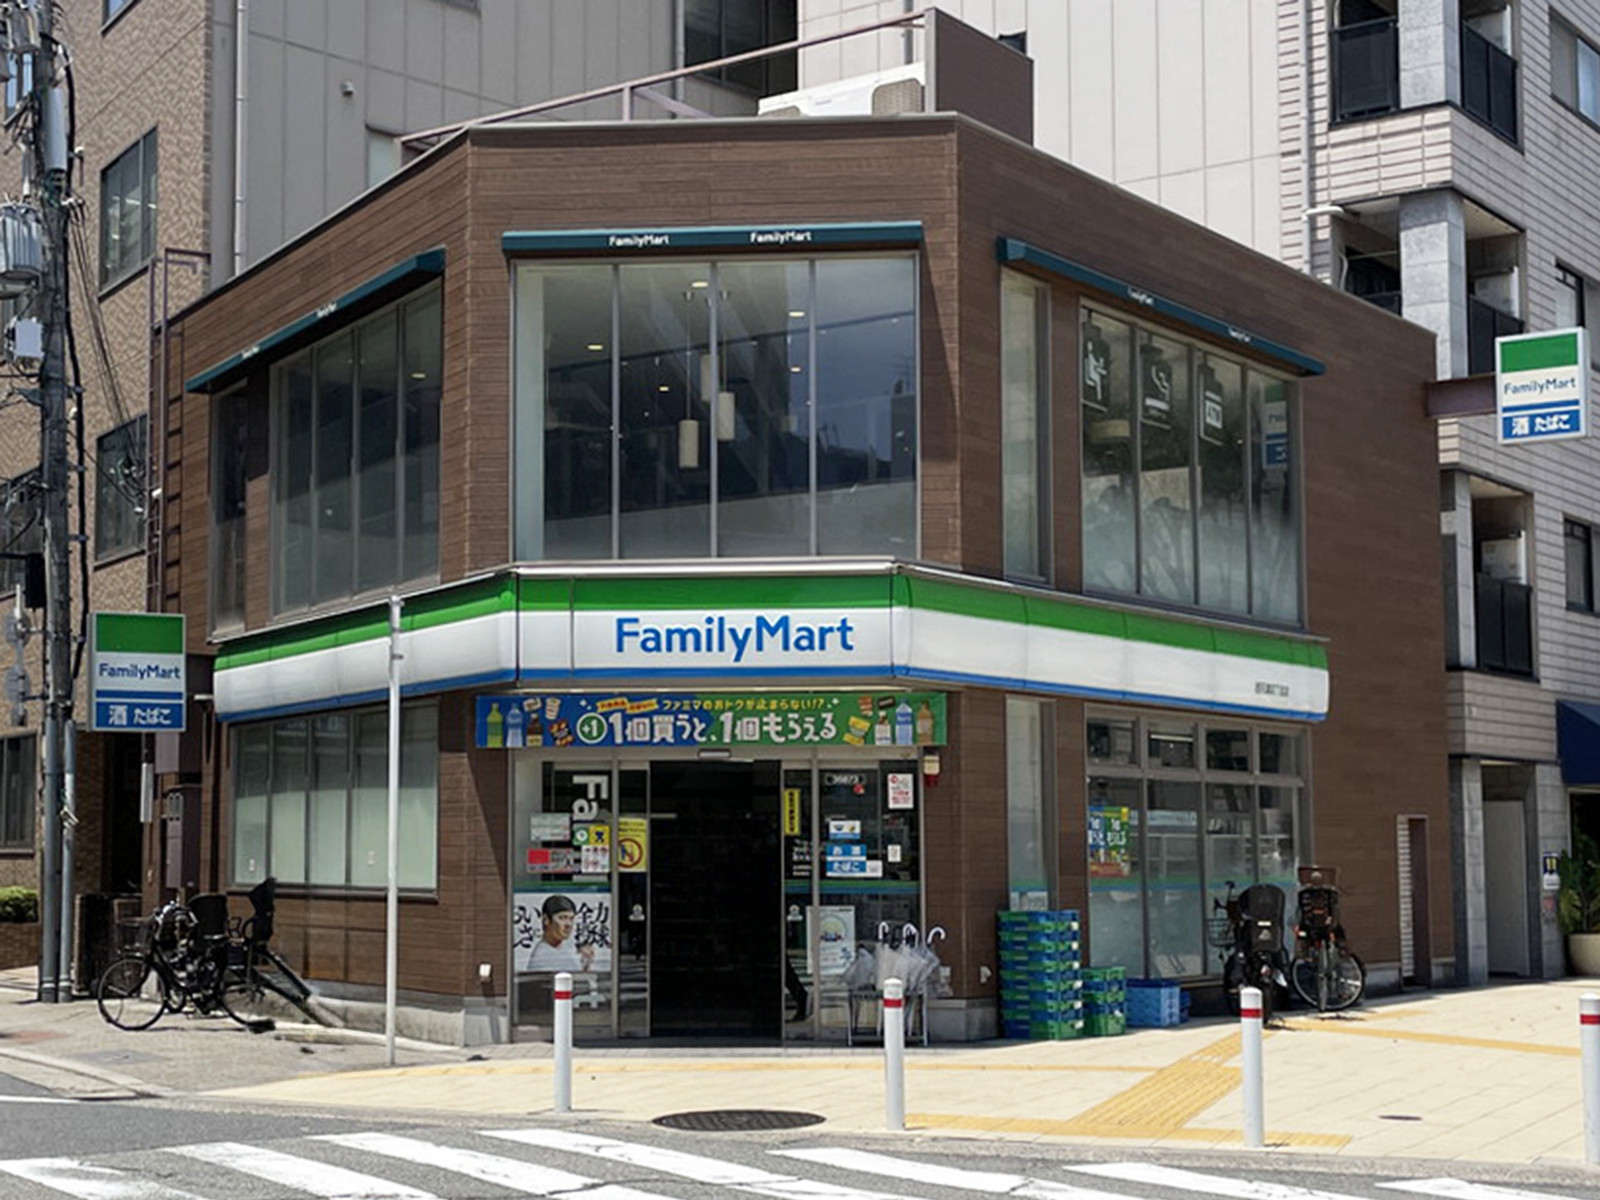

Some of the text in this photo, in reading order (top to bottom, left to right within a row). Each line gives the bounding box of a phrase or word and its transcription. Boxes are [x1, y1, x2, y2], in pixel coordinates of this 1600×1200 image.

[609, 234, 669, 247] FamilyMart
[750, 231, 811, 244] FamilyMart
[1503, 377, 1577, 394] FamilyMart
[1533, 413, 1571, 432] たばこ
[616, 615, 854, 662] FamilyMart
[99, 663, 180, 680] FamilyMart
[133, 707, 172, 725] たばこ
